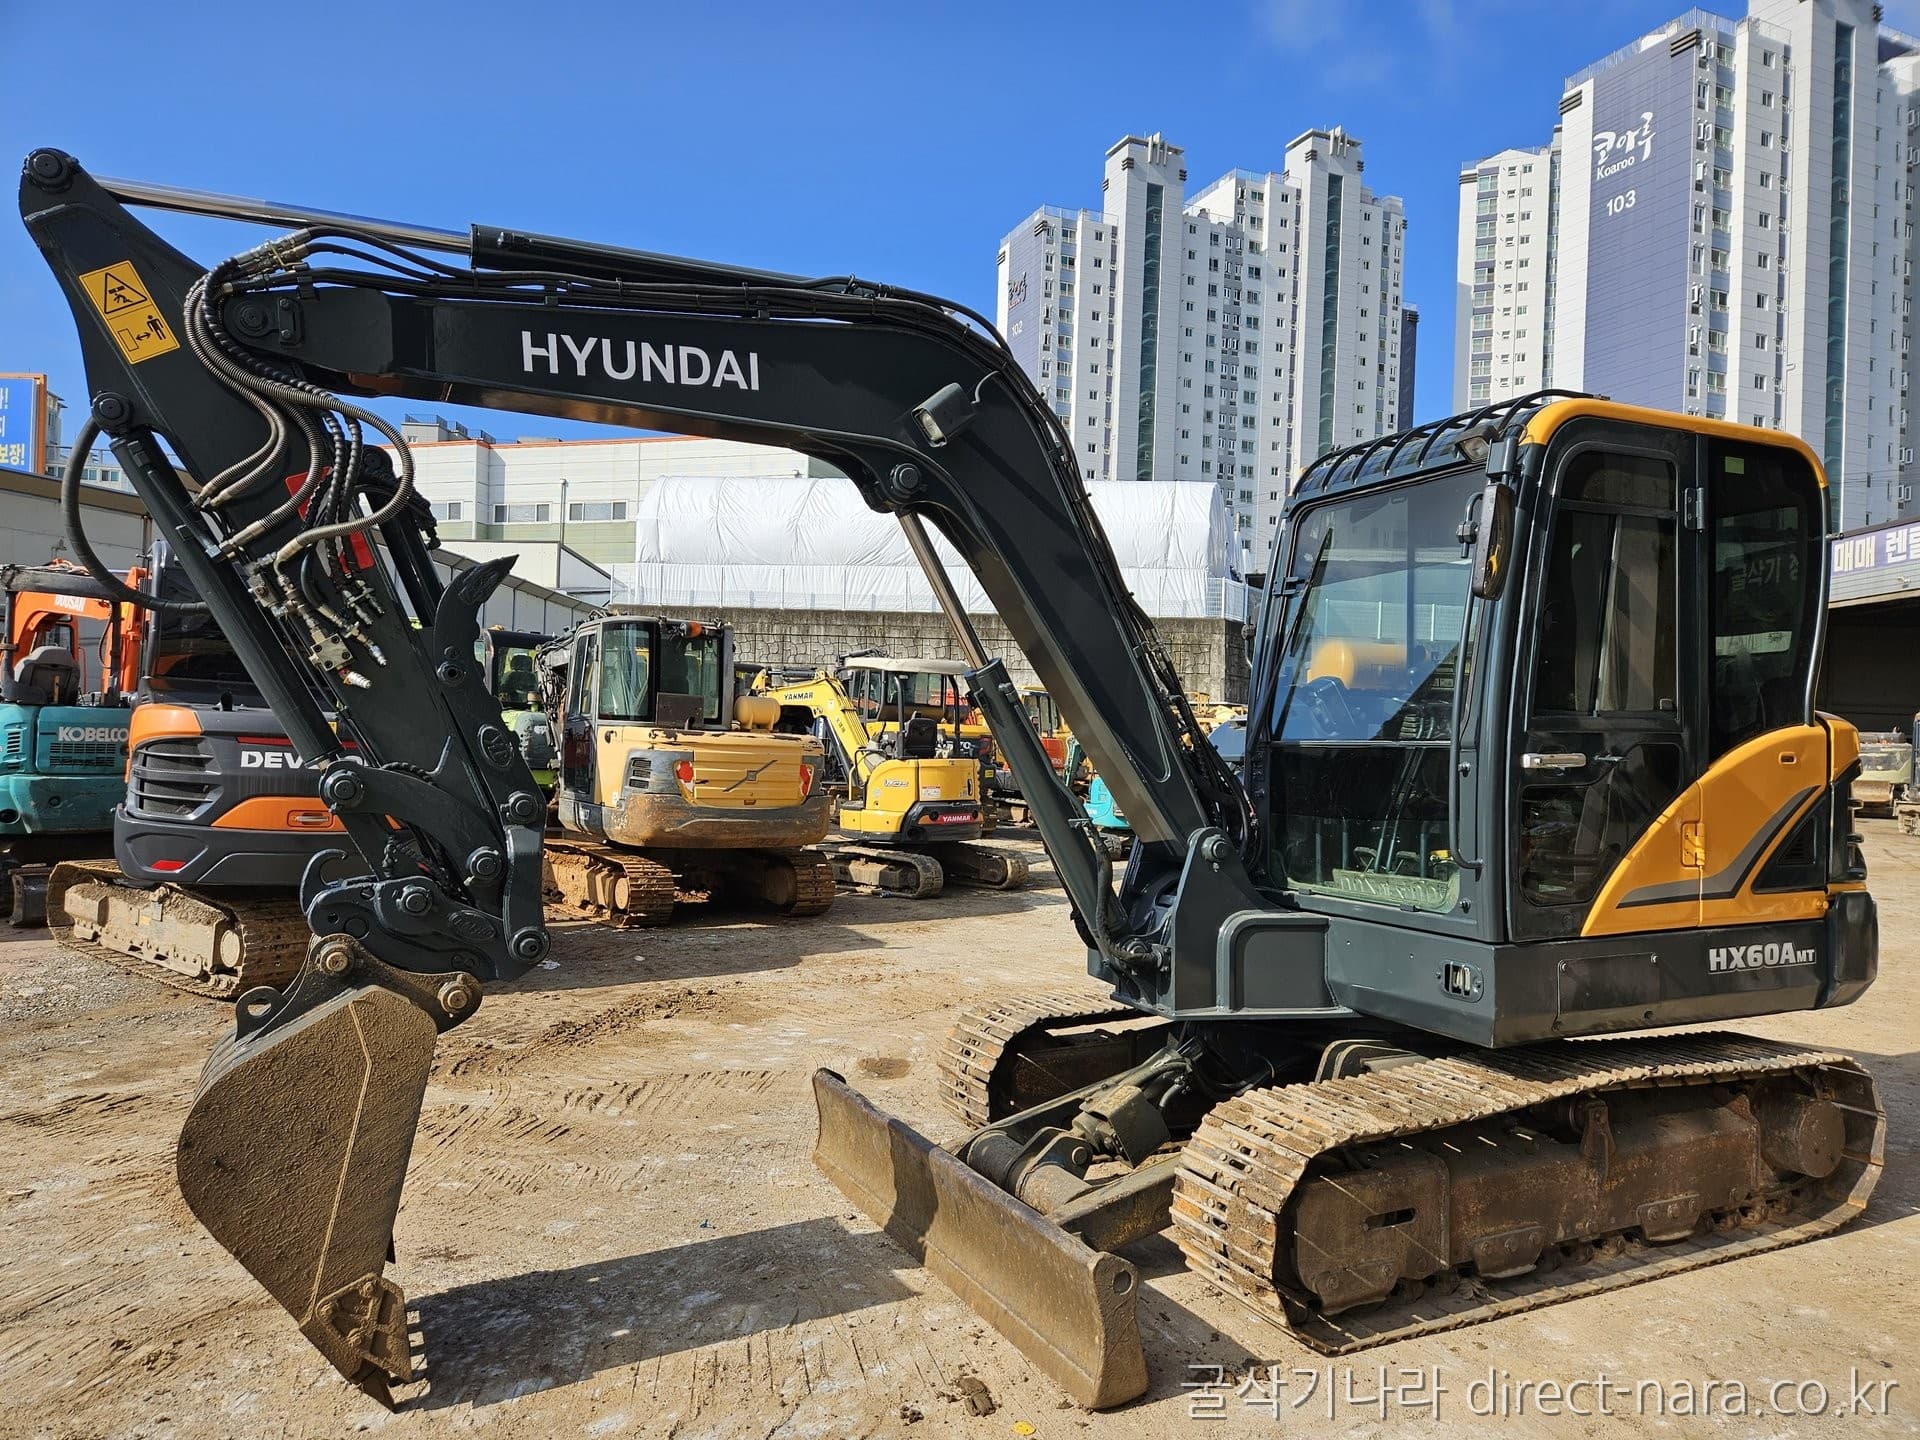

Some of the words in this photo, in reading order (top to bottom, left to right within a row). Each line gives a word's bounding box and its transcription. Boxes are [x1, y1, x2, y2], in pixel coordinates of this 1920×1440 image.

[1597, 156, 1635, 180] Koaroo
[1607, 190, 1636, 216] 103
[1012, 320, 1023, 336] 102
[521, 330, 760, 391] HYUNDAI
[1834, 535, 1876, 572] 매매
[784, 692, 814, 700] YANMAR
[58, 726, 129, 742] KOBELCO
